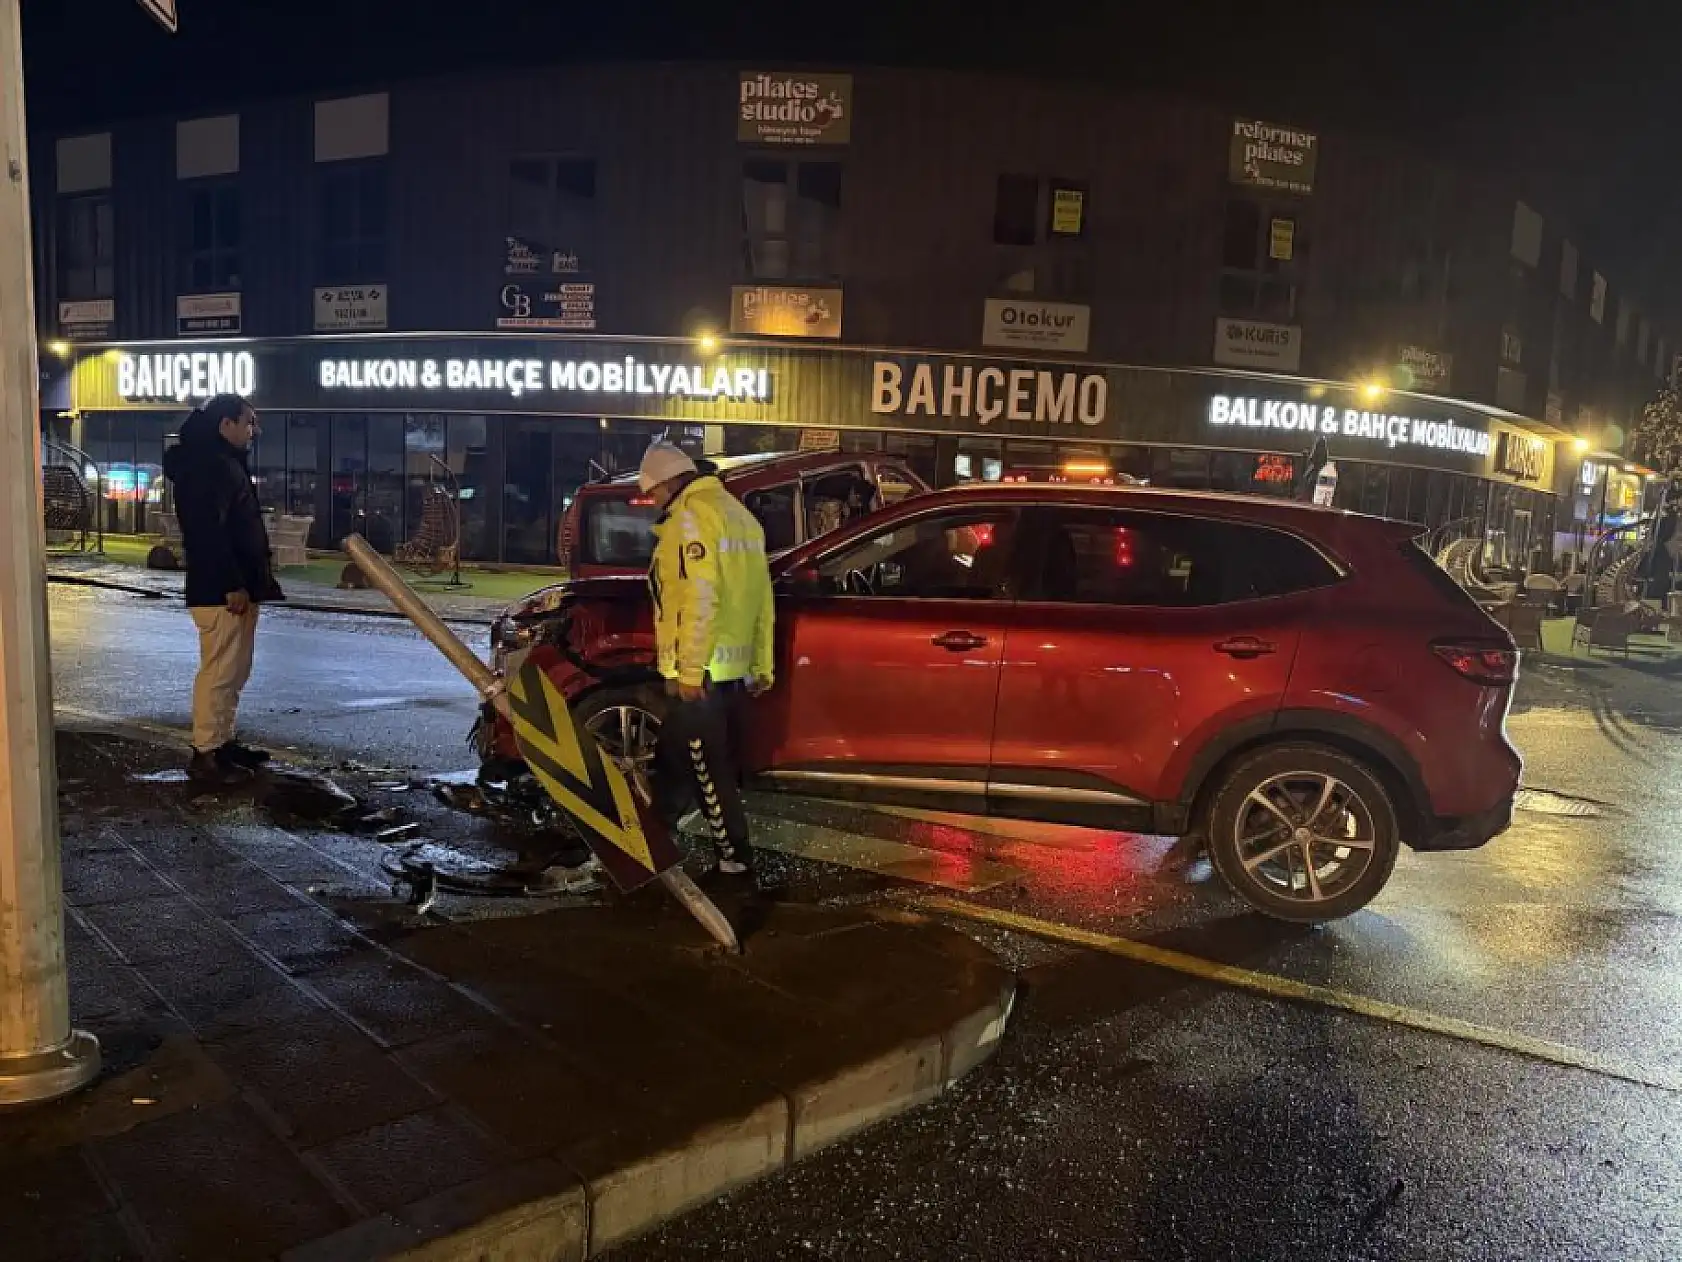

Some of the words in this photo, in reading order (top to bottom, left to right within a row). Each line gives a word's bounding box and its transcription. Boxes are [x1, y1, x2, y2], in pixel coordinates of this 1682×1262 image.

[741, 75, 818, 102] pilates
[741, 99, 816, 122] studio
[1235, 121, 1316, 148] reformer
[1245, 142, 1304, 165] pilates
[1001, 307, 1076, 327] Otokur
[119, 351, 255, 402] BAHÇEMO
[320, 359, 415, 387] BALKON
[421, 360, 441, 386] &
[446, 358, 542, 397] BAHÇE
[550, 356, 767, 399] MOBİLYALARI
[872, 362, 1107, 425] BAHÇEMO
[1209, 395, 1317, 431] BALKON
[1322, 406, 1339, 433] &
[1343, 409, 1410, 448] BAHÇE
